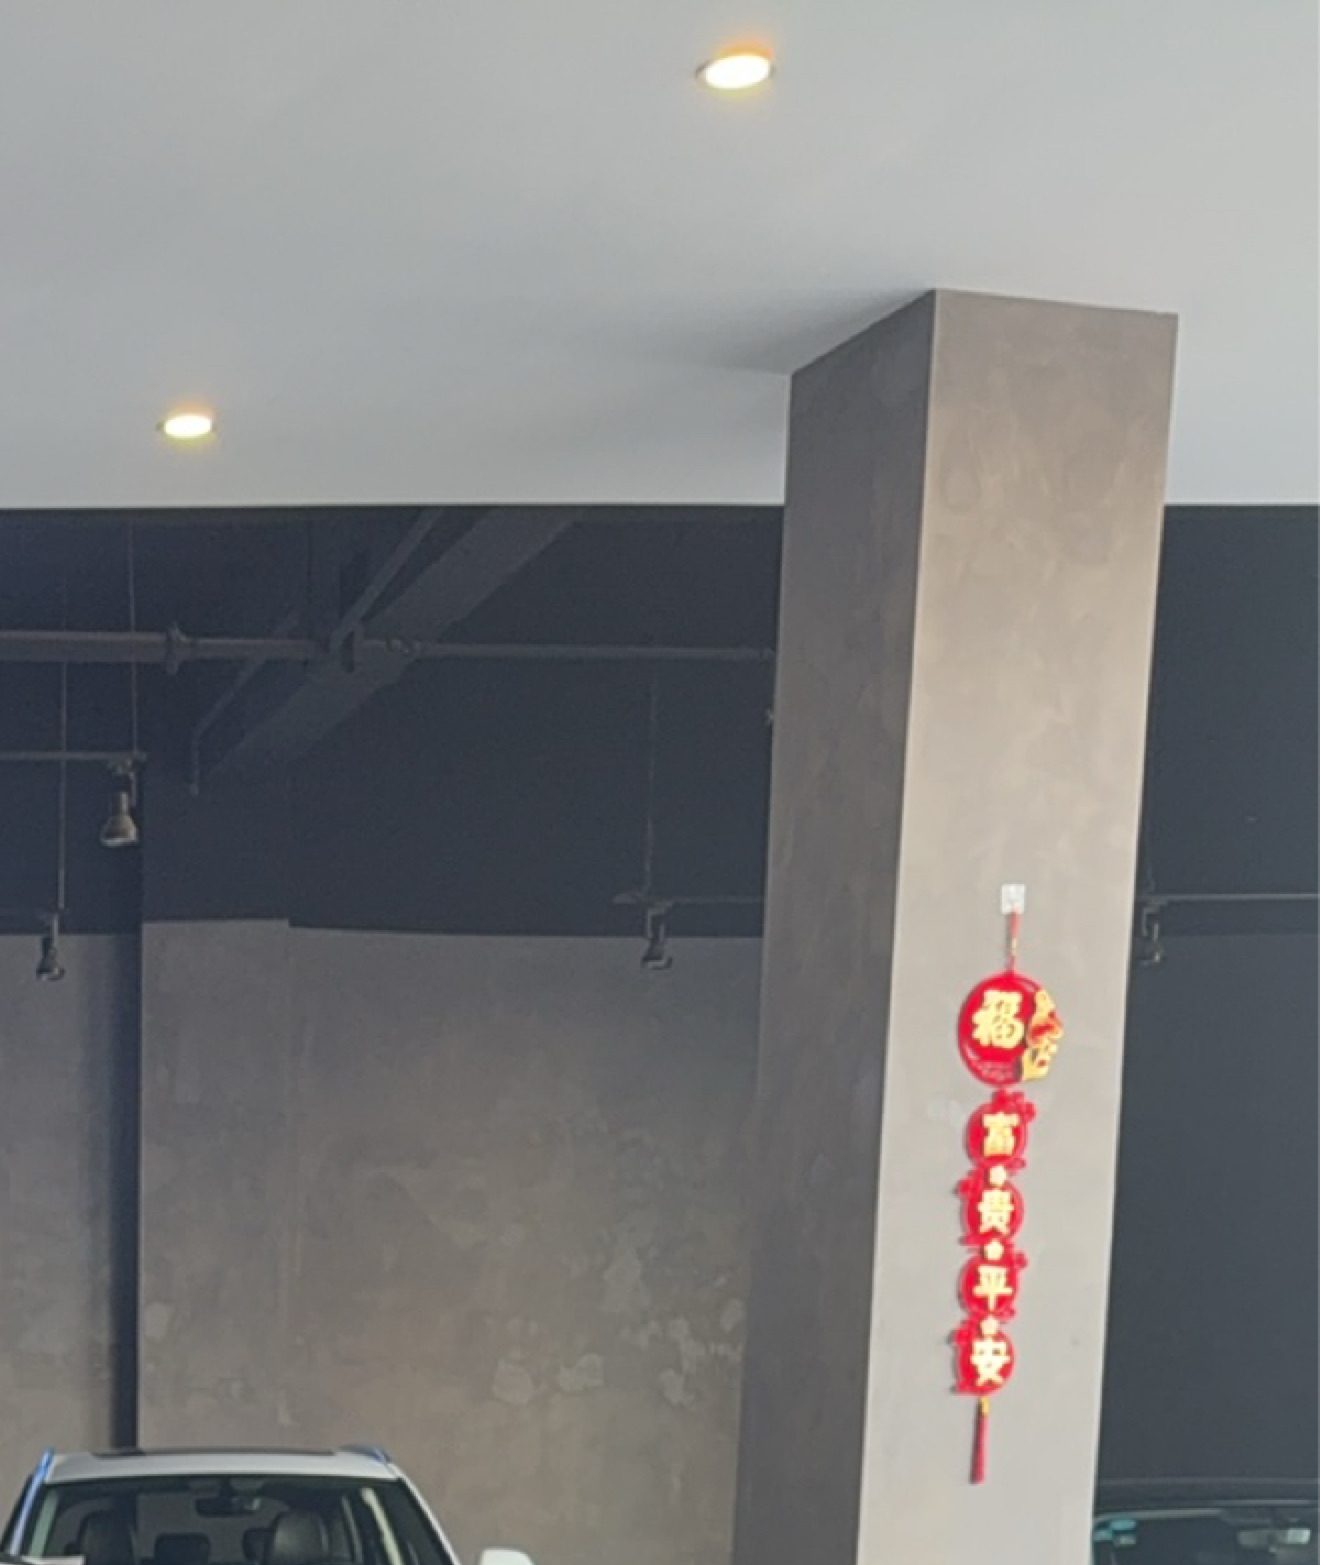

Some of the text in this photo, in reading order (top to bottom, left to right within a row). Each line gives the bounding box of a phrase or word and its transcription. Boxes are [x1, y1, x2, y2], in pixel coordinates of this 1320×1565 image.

[971, 989, 1025, 1049] 福
[969, 1111, 1019, 1387] 富贵平安
